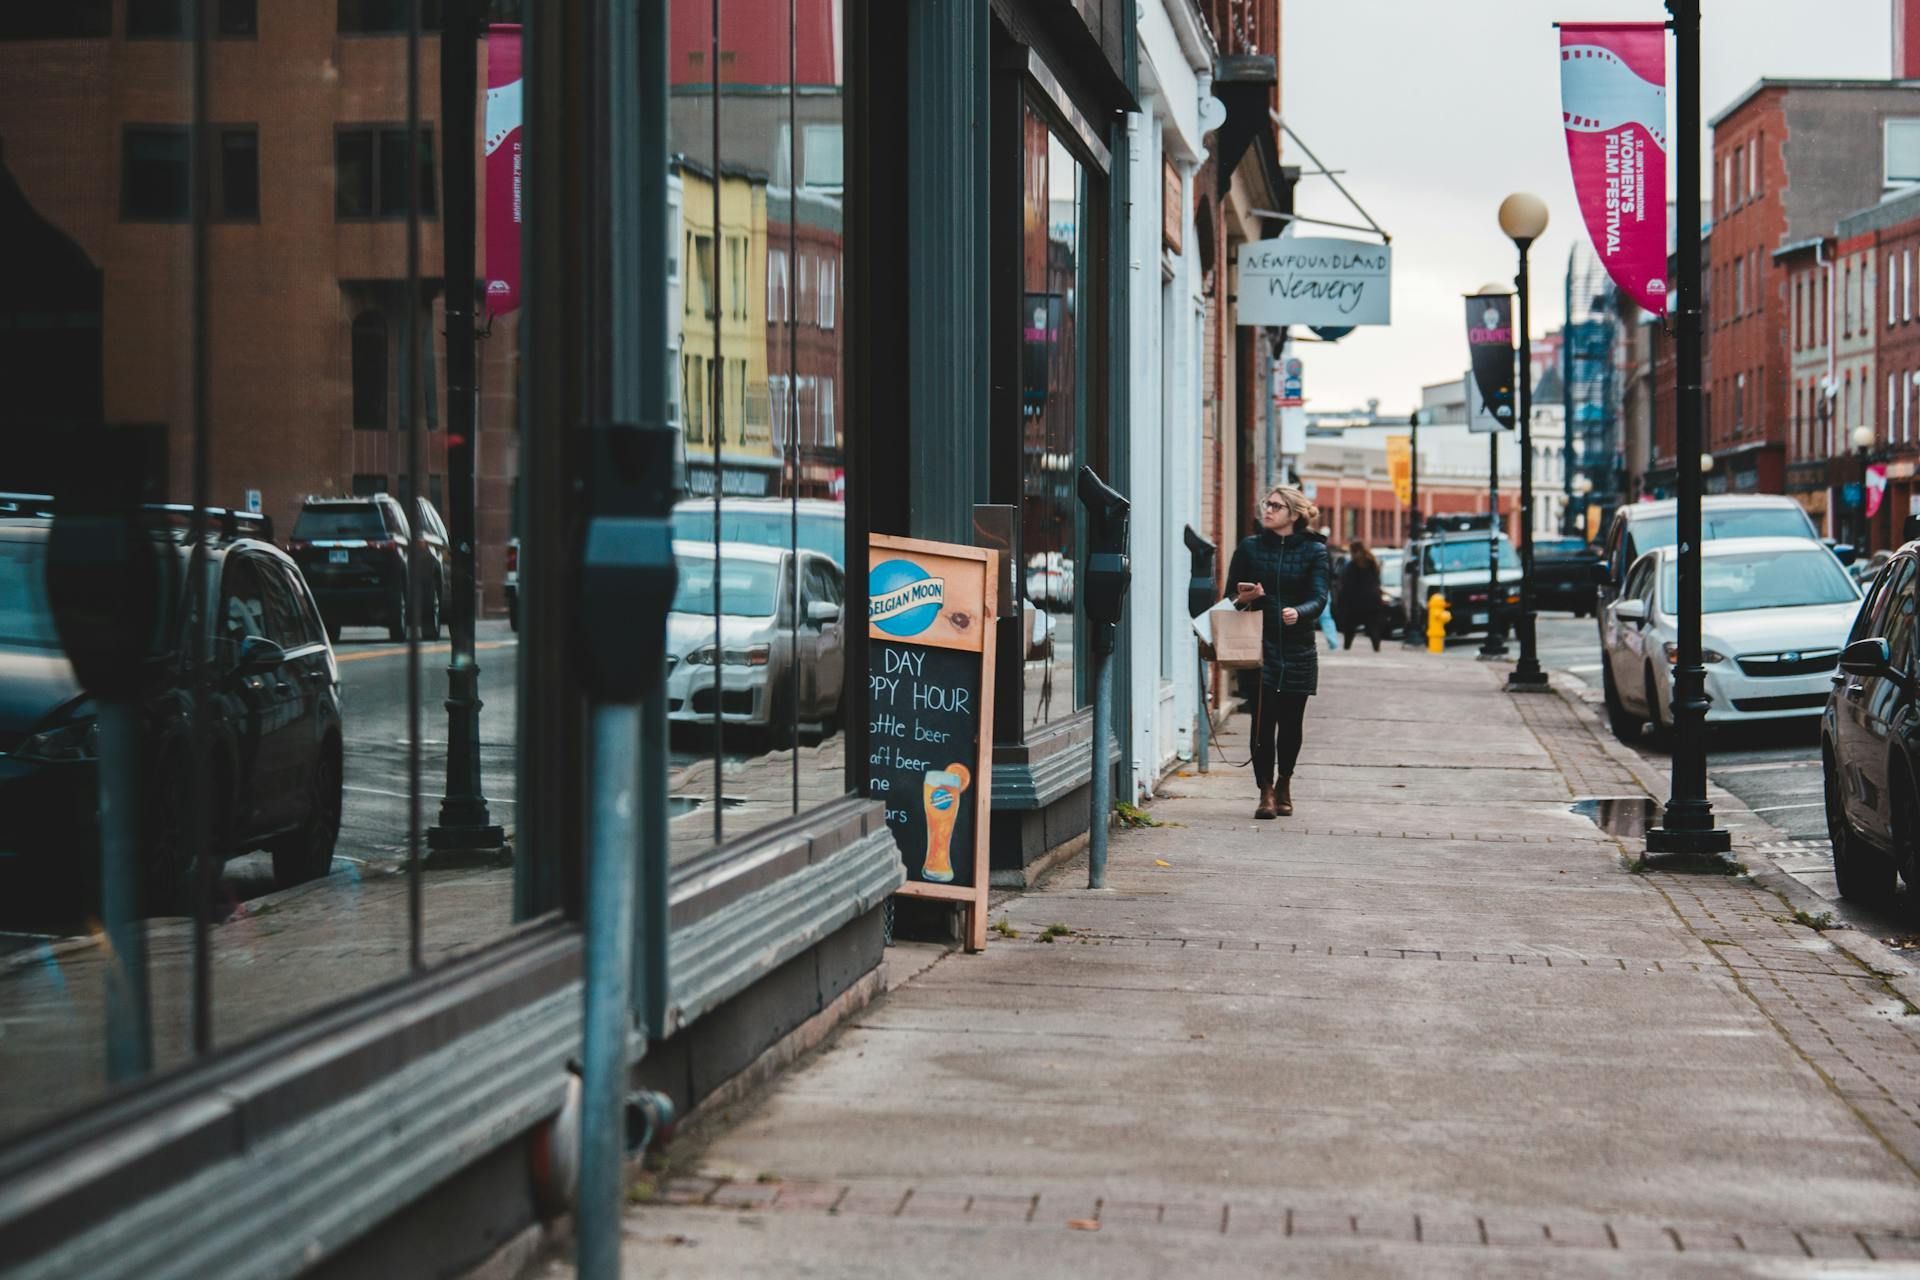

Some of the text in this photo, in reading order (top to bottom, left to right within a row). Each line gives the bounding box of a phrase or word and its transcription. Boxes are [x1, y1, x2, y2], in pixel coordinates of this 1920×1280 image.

[1620, 129, 1635, 214] WOMEN'S
[1605, 134, 1621, 256] FILM FESTIVAL
[1246, 252, 1386, 270] NEWFOUNDLAND
[1269, 272, 1365, 314] Weavery
[911, 583, 943, 602] MOON
[885, 647, 926, 677] DAY
[913, 681, 970, 715] HOUR
[914, 717, 951, 743] beer
[869, 746, 932, 771] aft beer
[869, 777, 890, 791] ne
